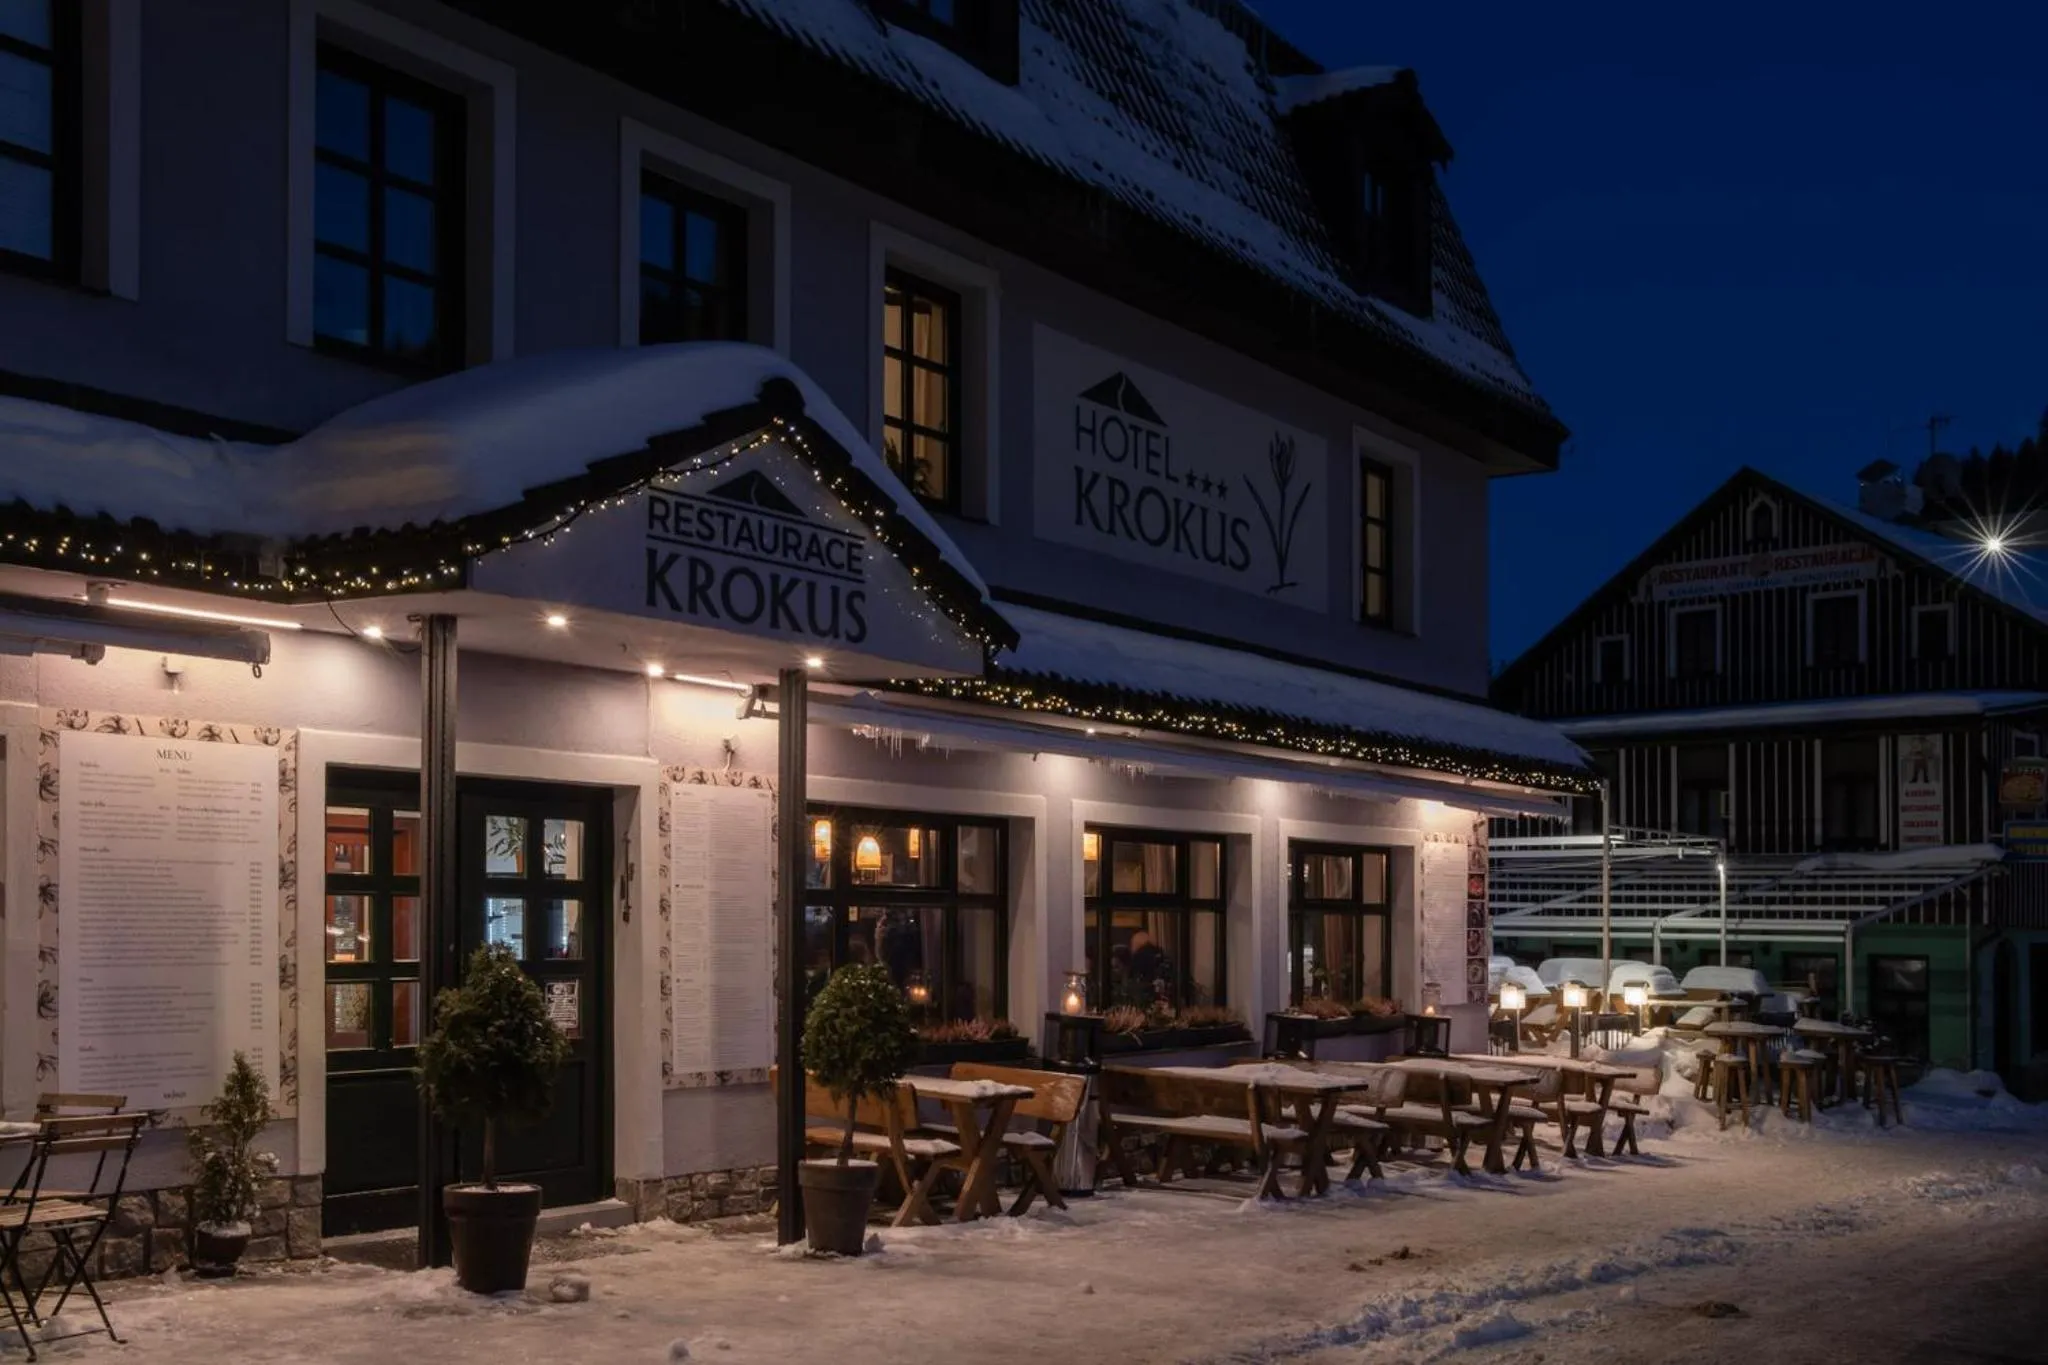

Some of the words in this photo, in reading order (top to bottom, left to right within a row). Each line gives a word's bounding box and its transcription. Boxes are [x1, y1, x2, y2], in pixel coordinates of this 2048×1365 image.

[1075, 402, 1179, 483] HOTEL
[647, 496, 865, 575] RESTAURACE
[1074, 465, 1251, 572] KROKUS
[645, 548, 868, 644] KROKUS
[1658, 561, 1748, 586] RESTAURANT
[156, 749, 192, 762] MENU
